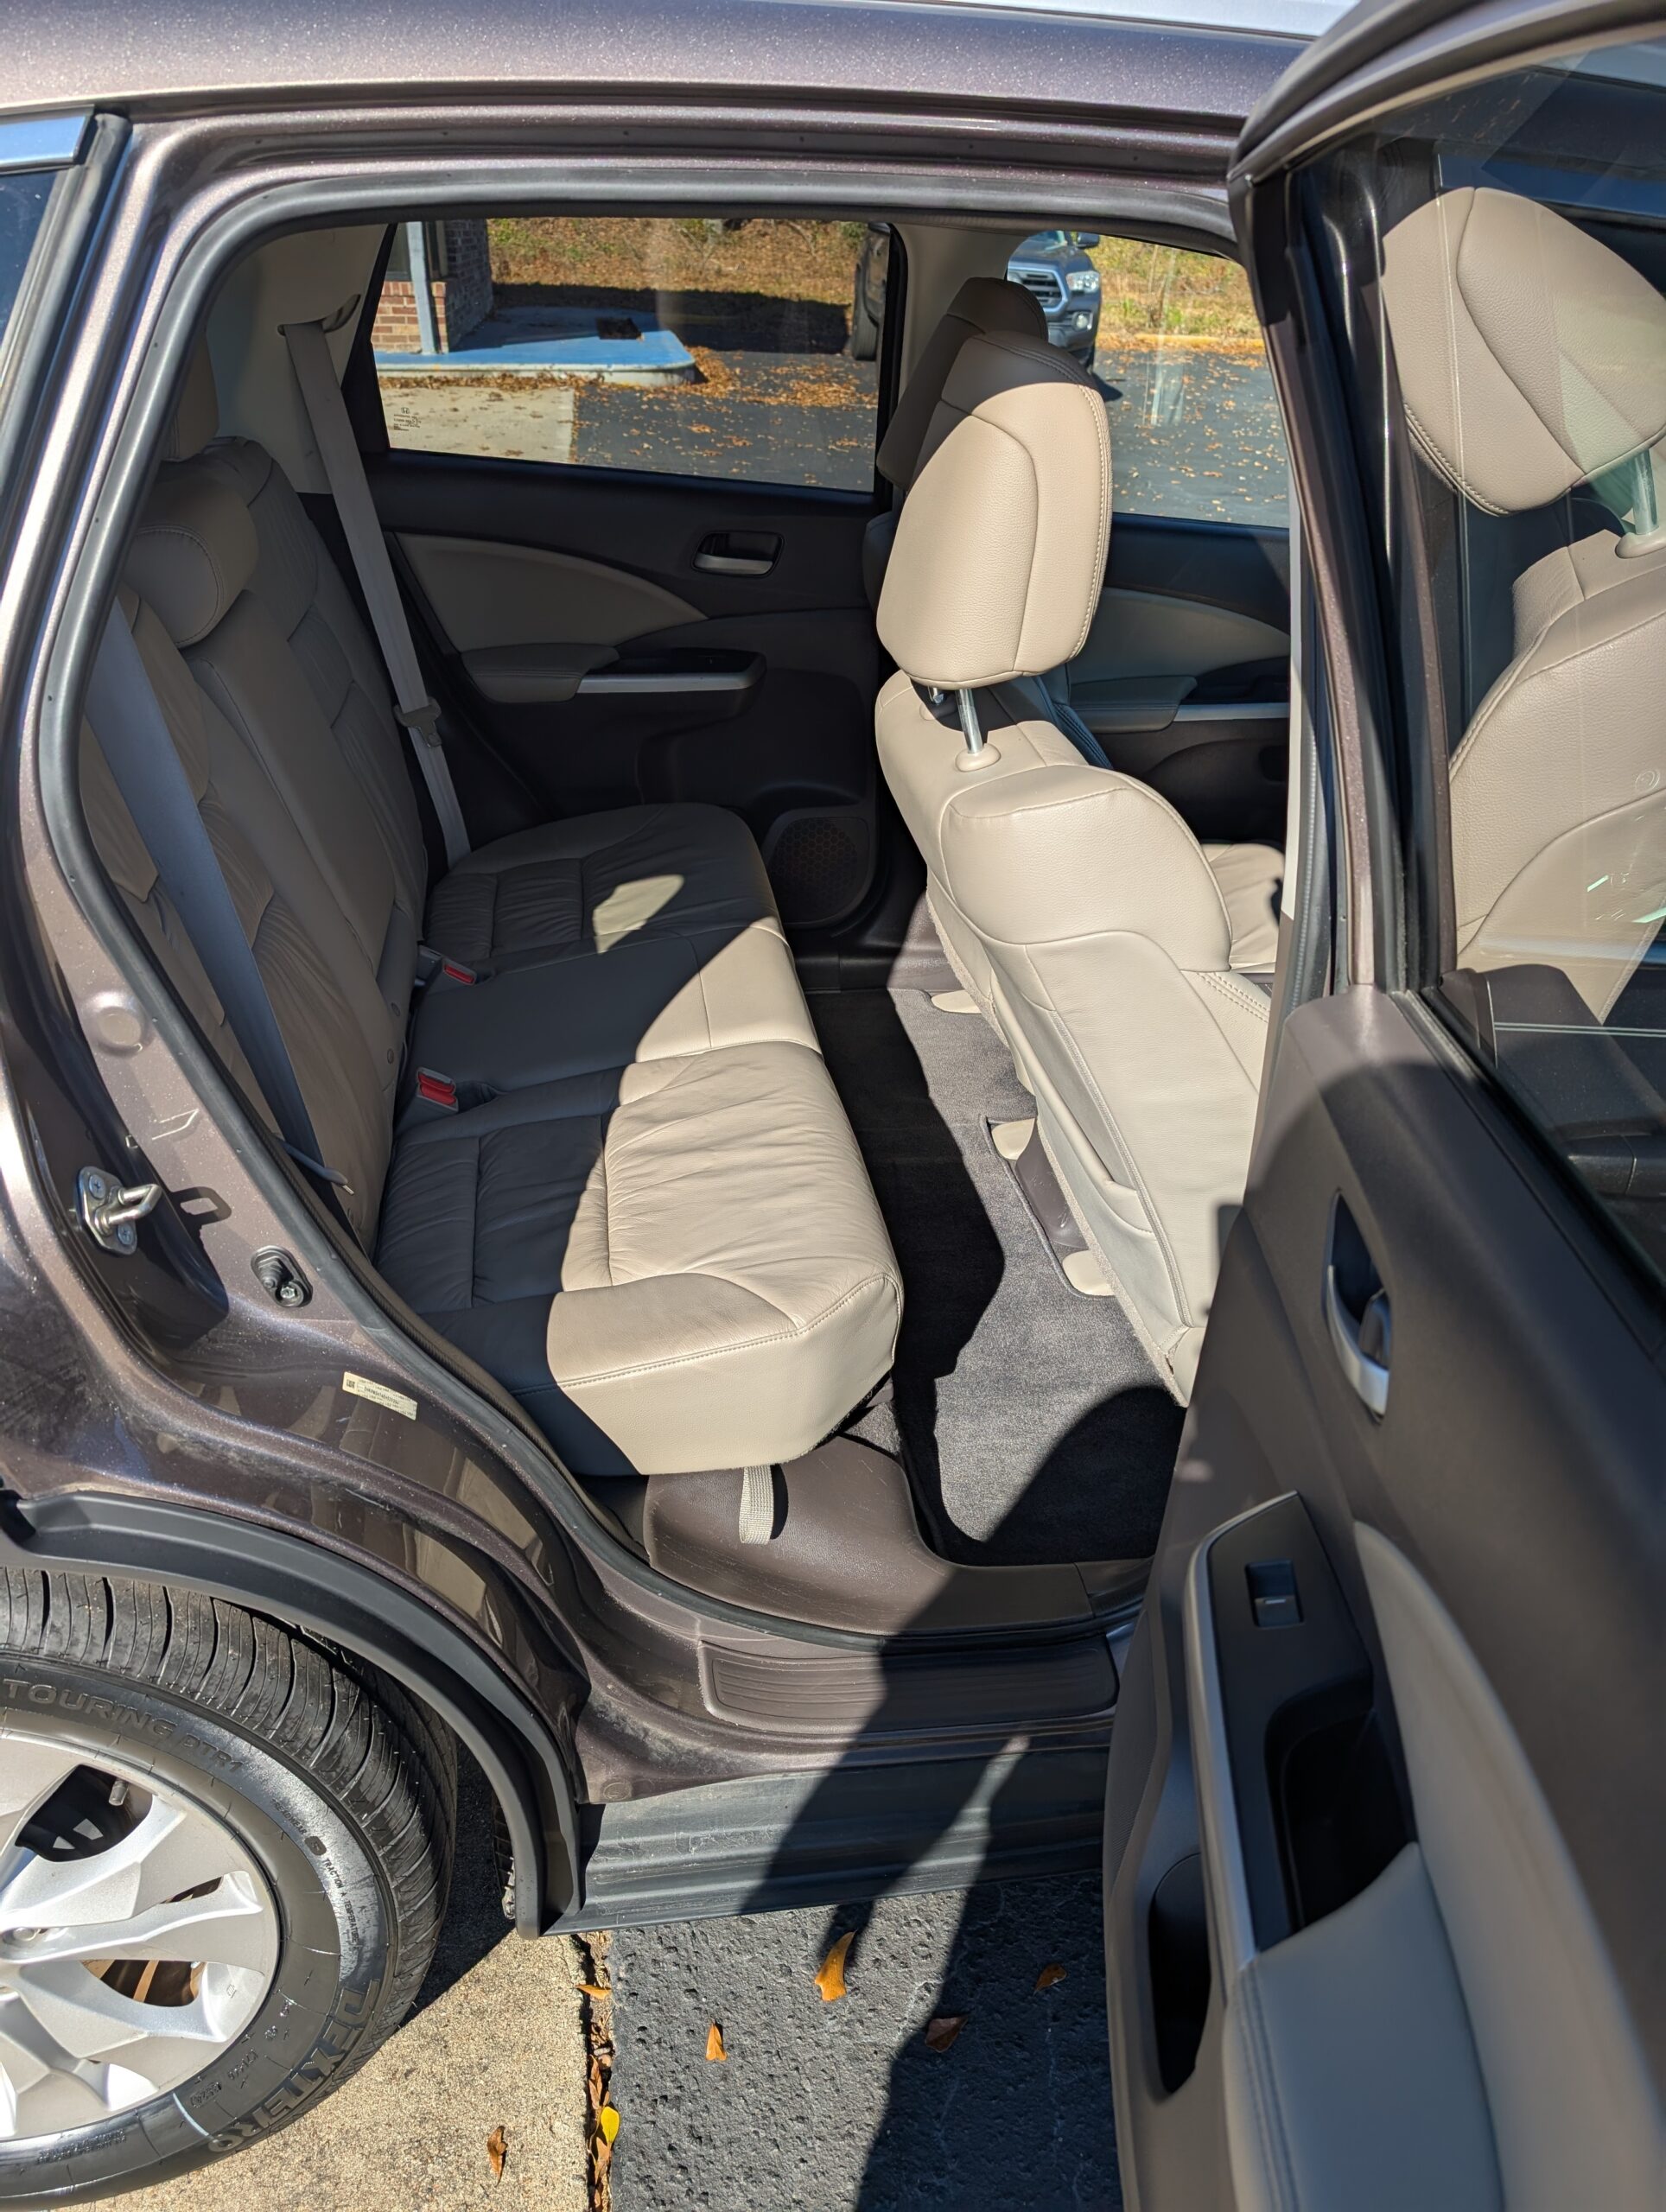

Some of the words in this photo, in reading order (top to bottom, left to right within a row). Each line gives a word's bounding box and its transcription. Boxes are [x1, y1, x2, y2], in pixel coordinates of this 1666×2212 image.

[3, 1678, 178, 1737] TOURING
[180, 1732, 244, 1772] DTR1
[321, 1858, 345, 1889] TRACTION
[344, 1899, 359, 1943] TEMPERATURE
[207, 1979, 380, 2152] DEXTERO
